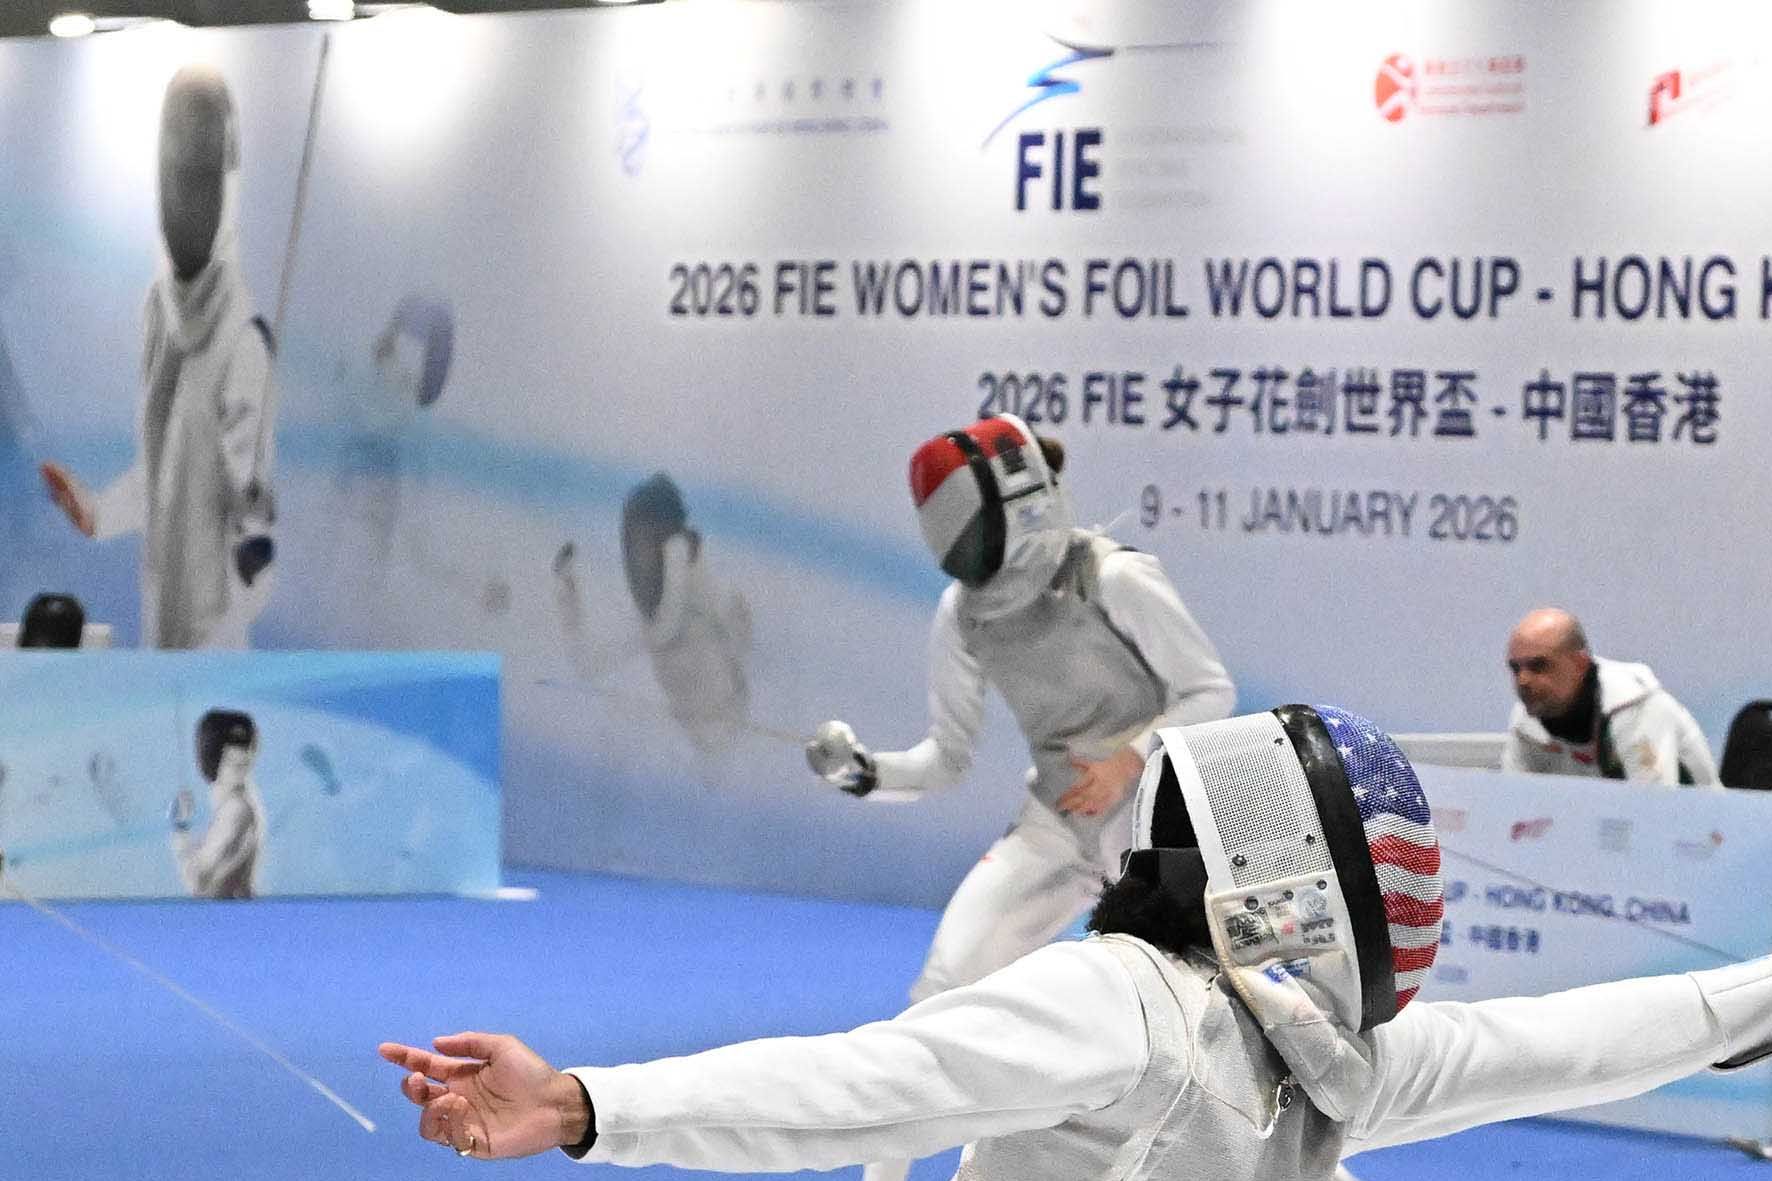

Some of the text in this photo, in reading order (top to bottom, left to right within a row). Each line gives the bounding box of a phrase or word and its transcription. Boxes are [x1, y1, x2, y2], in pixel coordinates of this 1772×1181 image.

[1014, 128, 1104, 211] FIE
[668, 262, 761, 318] 2026
[774, 259, 838, 318] FIE
[852, 258, 1069, 320] WOMEN'S
[1083, 257, 1190, 320] FOIL
[1204, 256, 1394, 320] WORLD
[1409, 256, 1522, 322] CUP
[1571, 254, 1738, 322] HONG
[978, 371, 1066, 424] 2026
[1081, 370, 1147, 426] FIE
[1520, 367, 1722, 444] 中國香港
[1139, 483, 1163, 529] 9
[1197, 488, 1229, 530] 11
[1241, 486, 1418, 537] JANUARY
[1428, 492, 1520, 542] 2026
